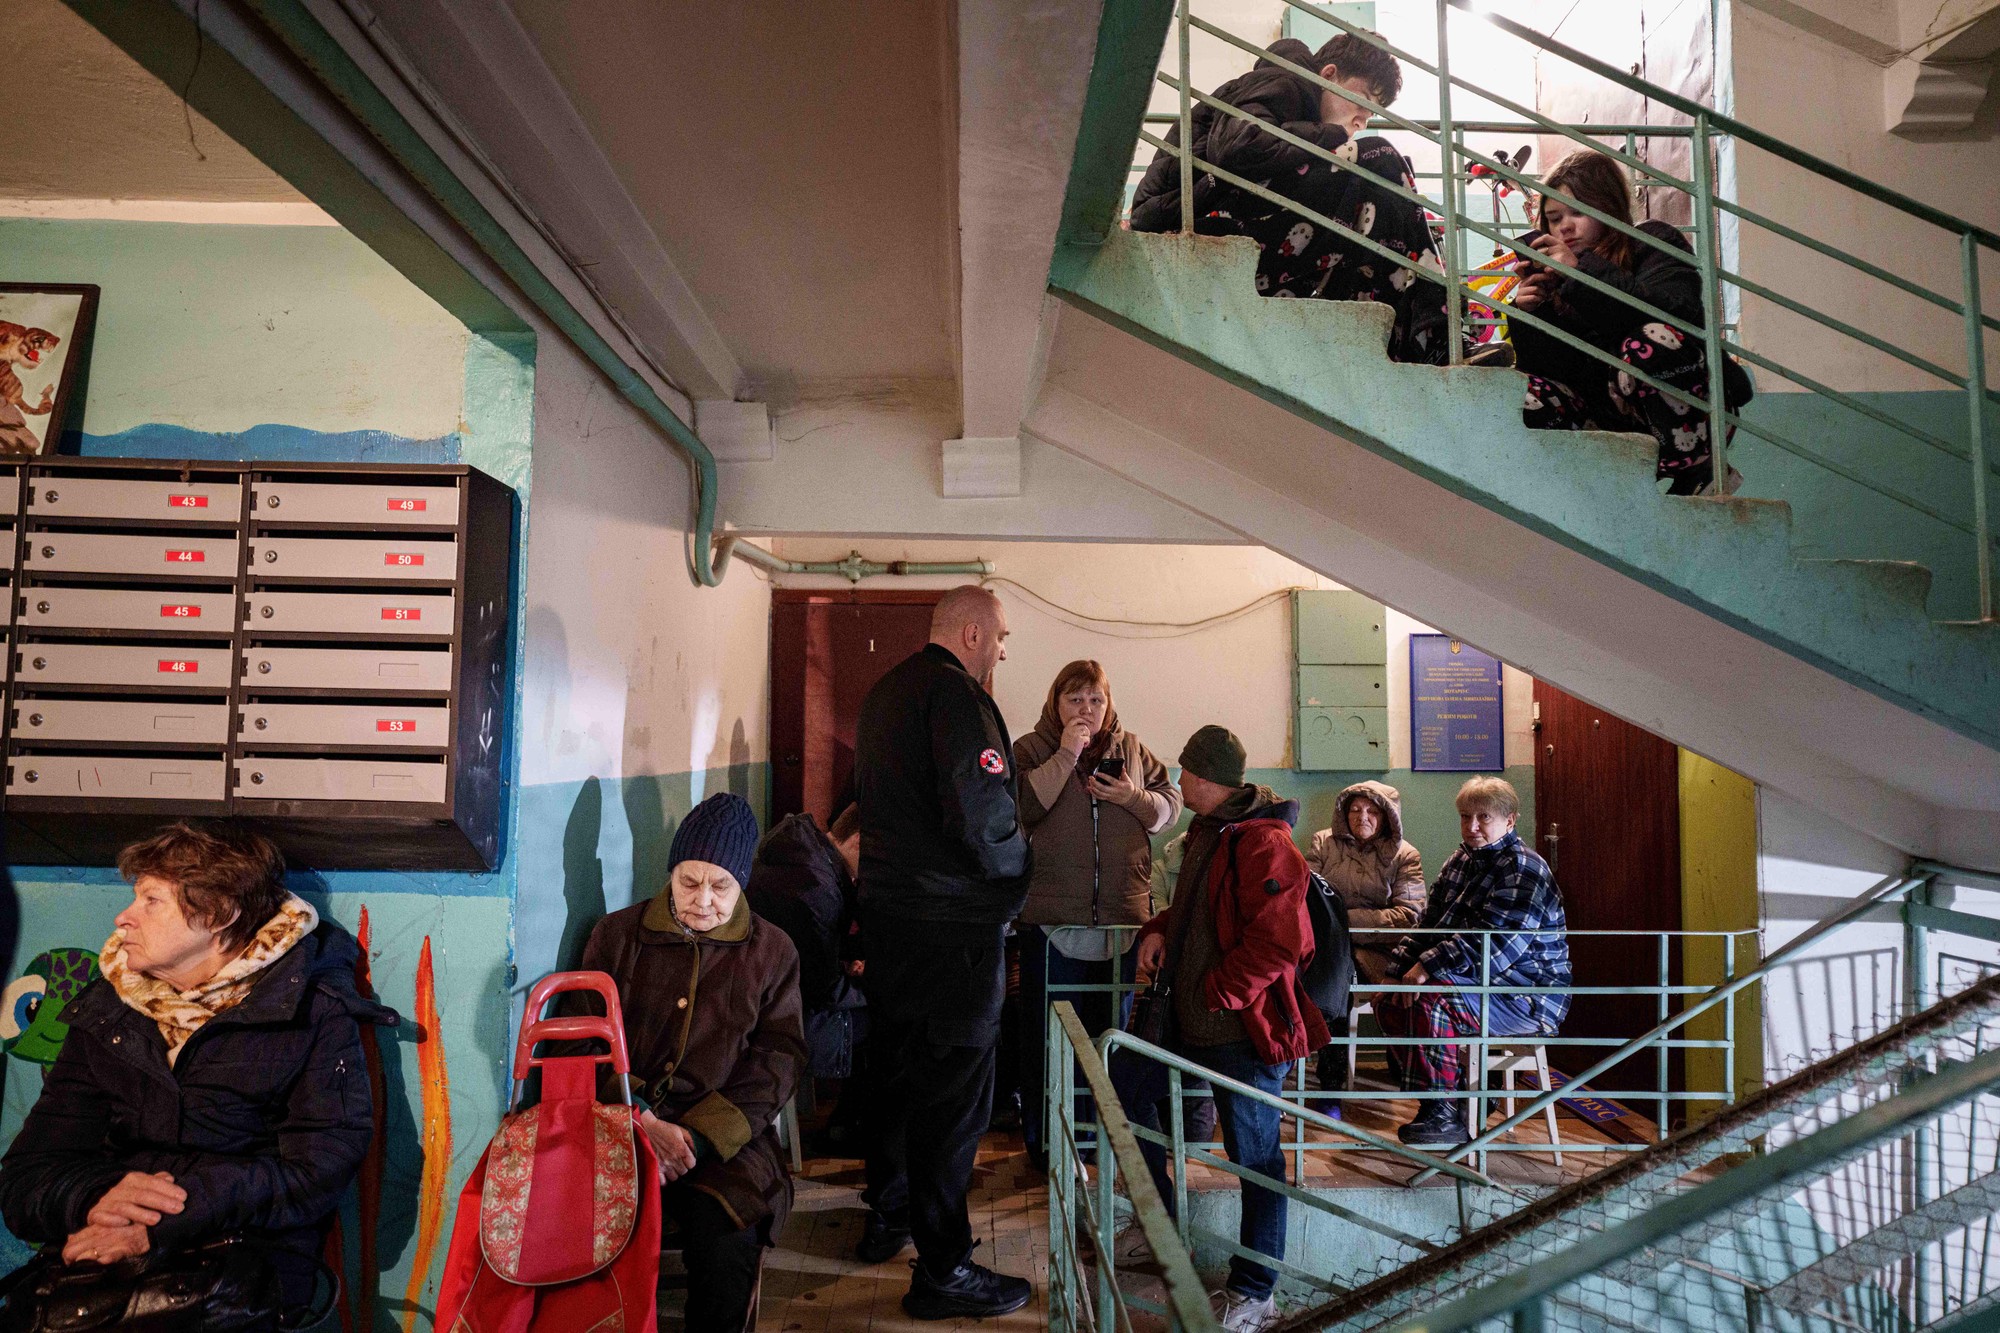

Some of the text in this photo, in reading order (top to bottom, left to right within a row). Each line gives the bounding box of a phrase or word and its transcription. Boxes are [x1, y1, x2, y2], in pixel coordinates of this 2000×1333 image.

[181, 496, 196, 507] 43
[400, 501, 414, 510] 49
[178, 552, 193, 561] 44
[398, 555, 412, 565] 50
[174, 607, 189, 616] 45
[395, 609, 408, 619] 51
[868, 639, 876, 652] 1
[171, 662, 186, 672] 46
[390, 721, 403, 731] 53
